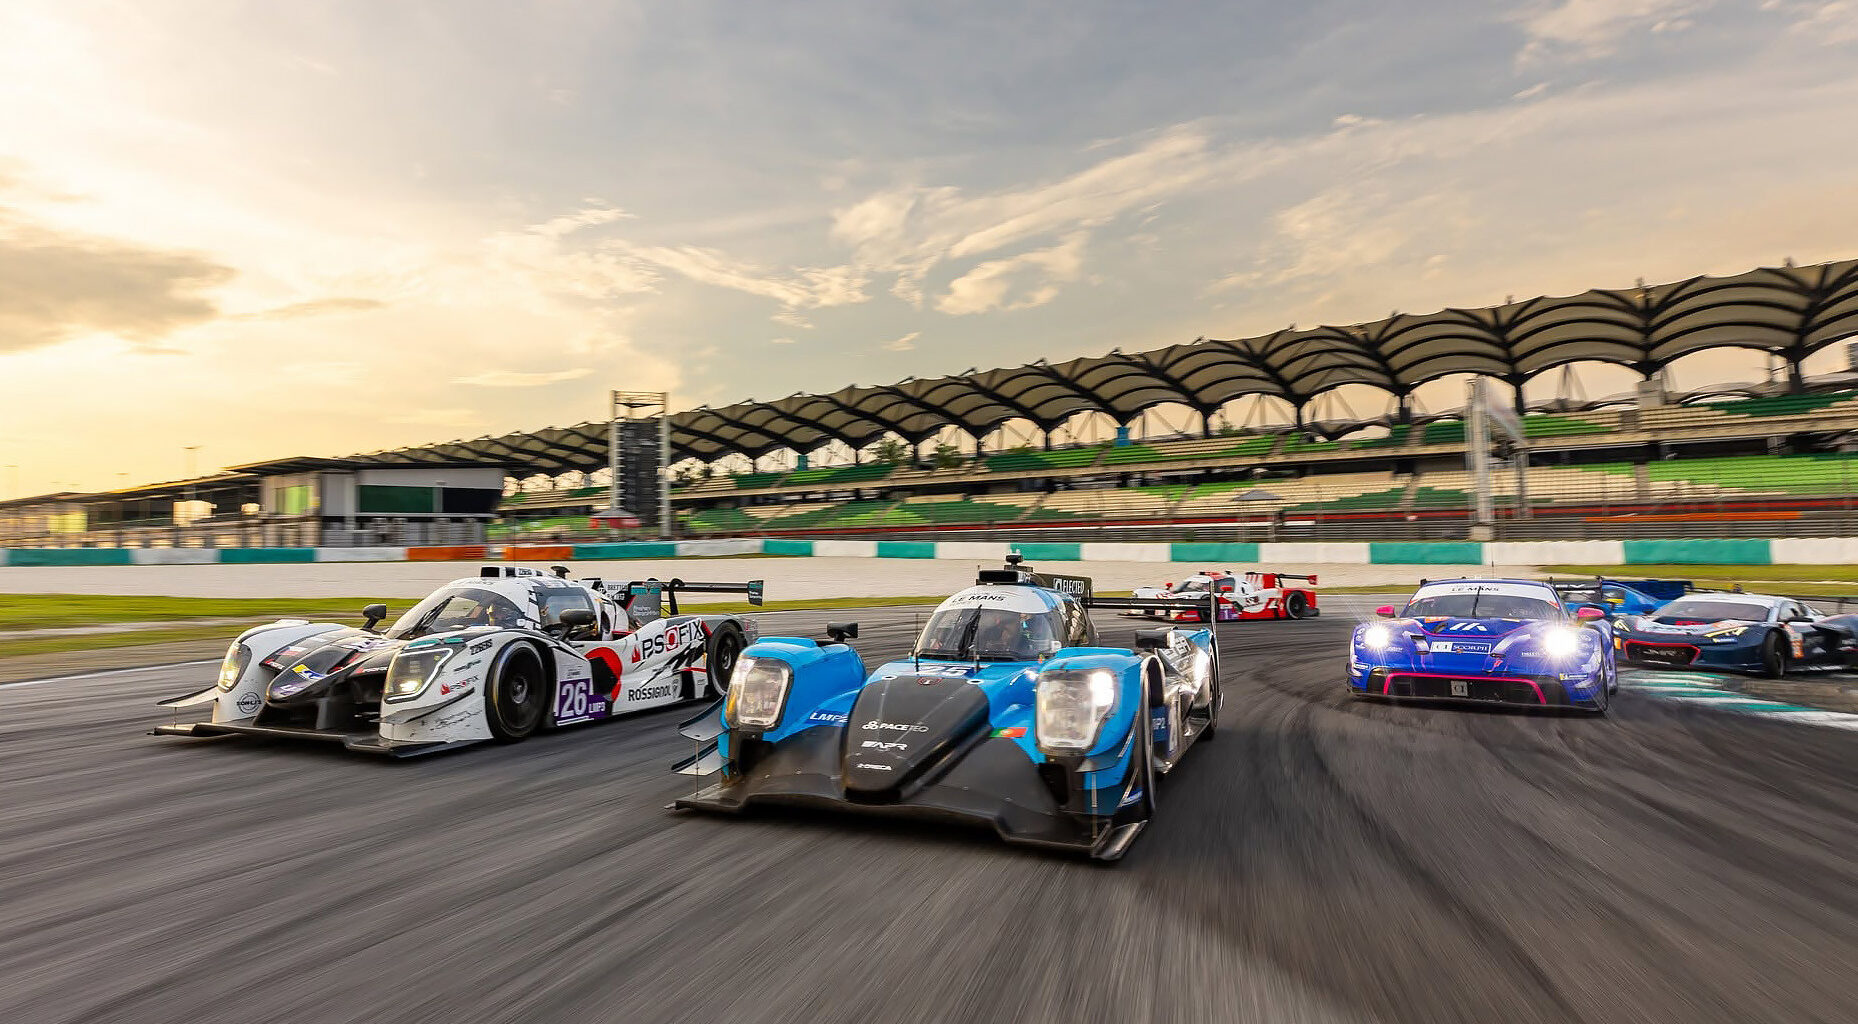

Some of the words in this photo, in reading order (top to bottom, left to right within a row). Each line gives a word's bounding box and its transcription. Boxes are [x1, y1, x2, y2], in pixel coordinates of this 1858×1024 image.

[641, 621, 703, 660] PSOFIX
[560, 681, 588, 717] 26
[628, 684, 672, 701] ROSSIGNOL
